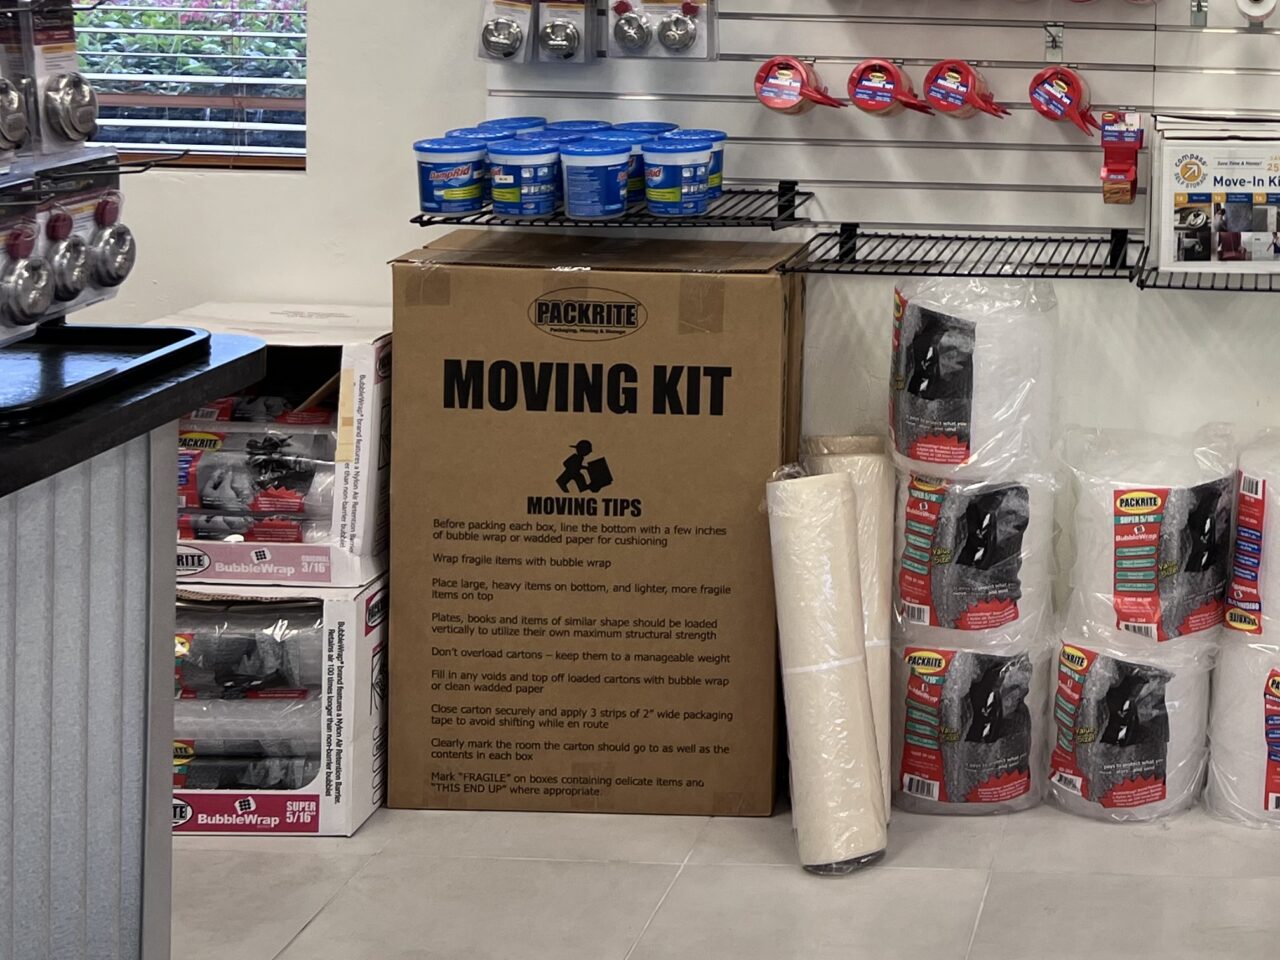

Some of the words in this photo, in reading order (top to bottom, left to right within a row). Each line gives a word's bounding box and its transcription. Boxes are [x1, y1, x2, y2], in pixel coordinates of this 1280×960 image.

[430, 164, 472, 180] DampRid
[1213, 175, 1265, 187] Move-In
[537, 301, 637, 327] PACKRITE
[443, 358, 639, 414] MOVING
[652, 365, 733, 416] KIT
[527, 496, 598, 516] MOVING
[601, 498, 642, 517] TIPS
[1119, 497, 1158, 507] PACKRITE
[433, 519, 465, 529] Before
[468, 520, 506, 532] packing
[509, 521, 532, 531] each
[536, 522, 557, 533] box,
[560, 523, 578, 532] line
[582, 523, 597, 533] the
[601, 523, 636, 533] bottom
[640, 524, 661, 534] with
[664, 526, 670, 534] a
[674, 525, 691, 534] few
[695, 525, 727, 536] inches
[433, 530, 443, 540] of
[446, 531, 479, 540] bubble
[482, 533, 507, 543] wrap
[523, 533, 562, 543] wadded
[565, 535, 594, 546] paper
[598, 535, 611, 544] for
[614, 536, 668, 548] cushioning
[1115, 533, 1157, 542] BubbleWrap
[215, 561, 295, 577] BubbleWrap
[433, 553, 458, 564] Wrap
[462, 554, 492, 566] fragile
[495, 555, 522, 566] items
[525, 556, 546, 566] with
[550, 557, 583, 567] bubble
[587, 559, 611, 569] wrap
[432, 578, 457, 588] Place
[461, 579, 488, 591] large,
[492, 580, 521, 592] heavy
[524, 581, 551, 591] items
[554, 583, 567, 591] on
[570, 582, 609, 593] bottom,
[613, 583, 631, 593] and
[634, 583, 668, 595] lighter,
[671, 586, 697, 594] more
[700, 584, 731, 596] fragile
[907, 655, 943, 668] PACKRITE
[336, 666, 344, 685] brand
[336, 686, 344, 713] features
[335, 718, 344, 737] Nylon
[335, 748, 343, 781] Retention
[286, 801, 316, 811] SUPER
[197, 813, 280, 827] BubbleWrap
